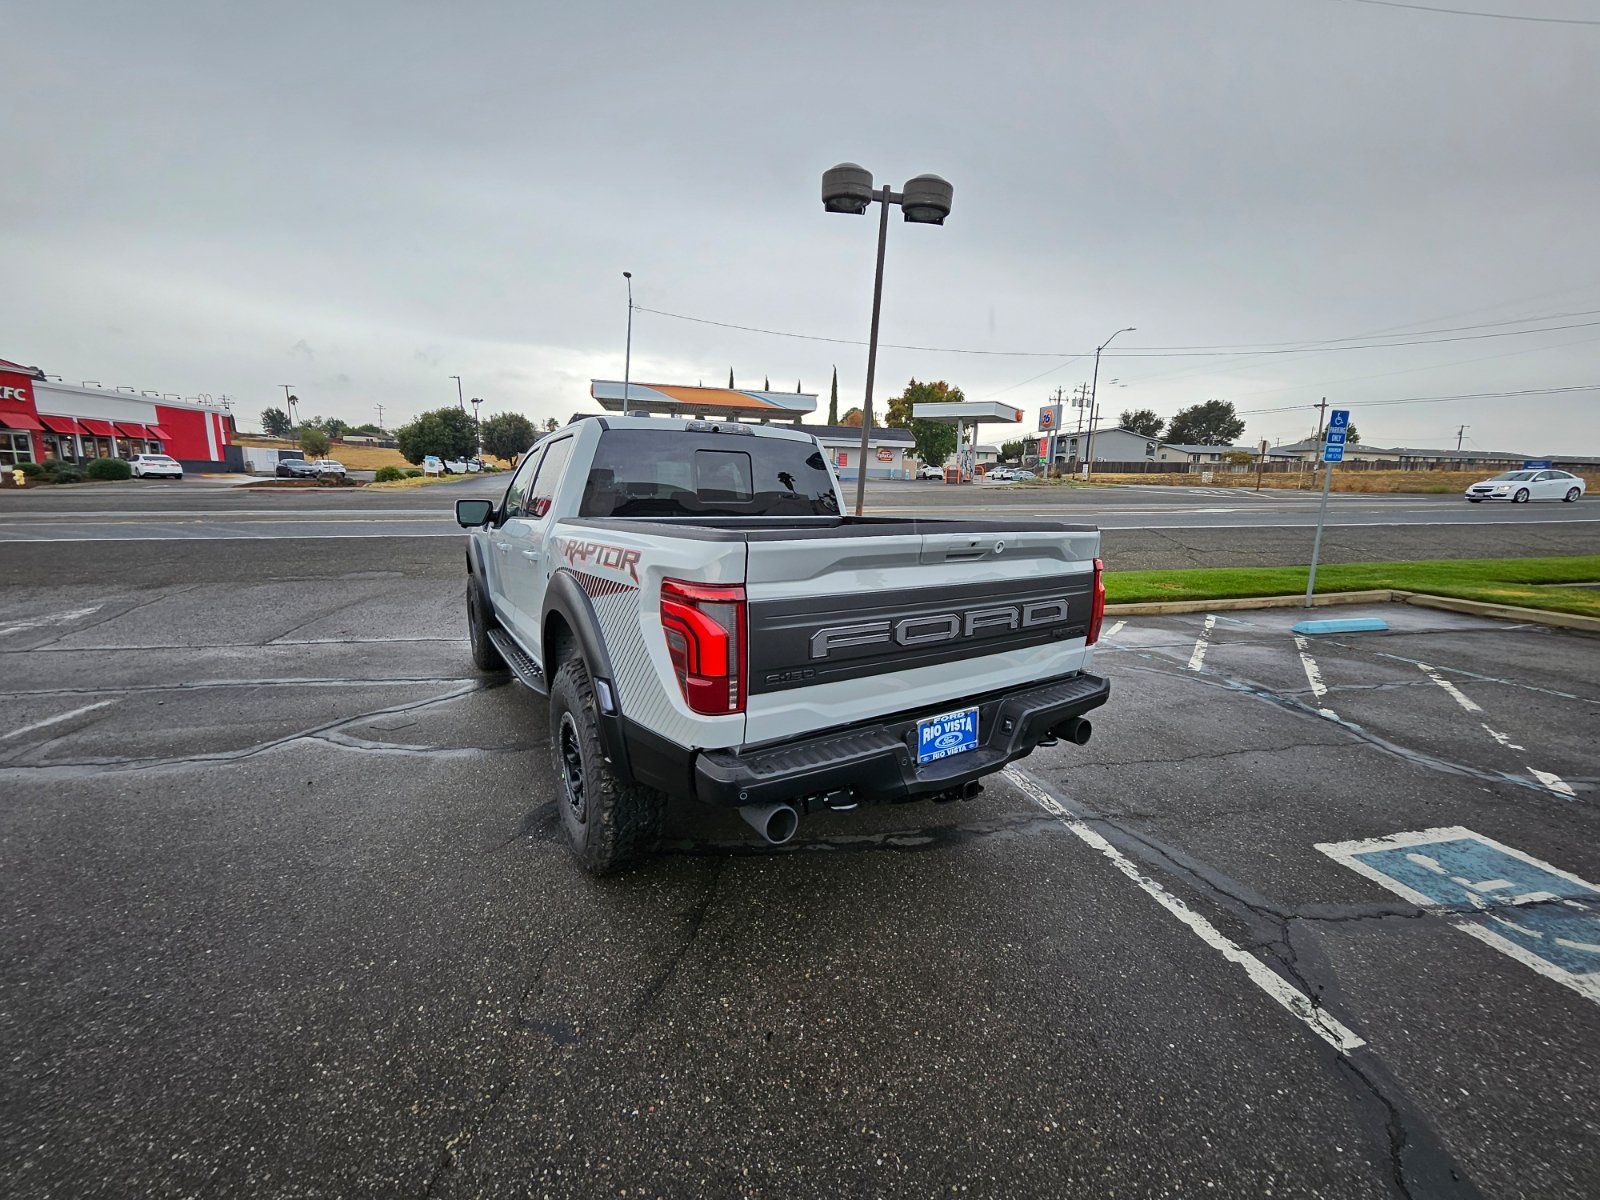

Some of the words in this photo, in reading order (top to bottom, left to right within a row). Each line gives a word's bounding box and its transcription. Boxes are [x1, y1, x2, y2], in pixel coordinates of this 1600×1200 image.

[1329, 426, 1346, 434] PARKING
[1331, 434, 1342, 442] ONLY
[565, 539, 642, 586] RAPTOR
[810, 599, 1069, 659] FORD
[934, 711, 965, 724] FORD
[923, 724, 942, 746] RIO
[944, 716, 973, 733] VISTA
[932, 751, 946, 761] RIO
[947, 745, 968, 755] VISTA
